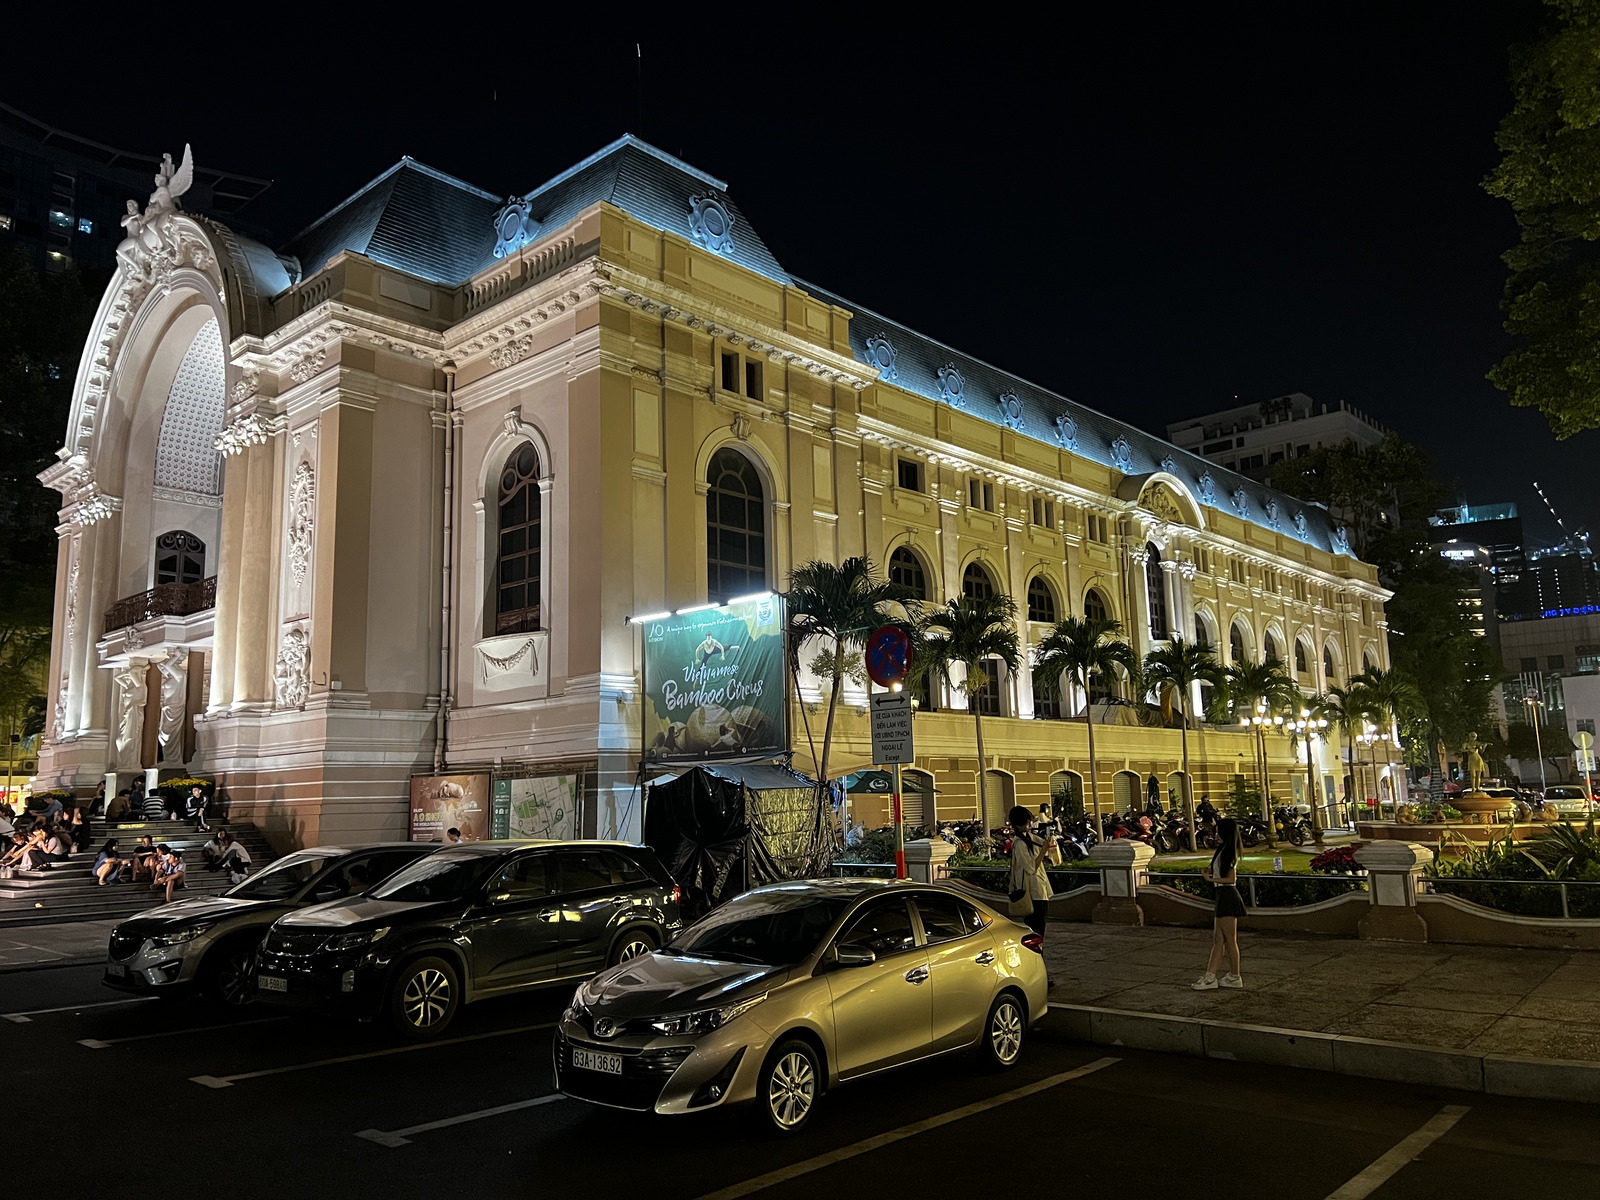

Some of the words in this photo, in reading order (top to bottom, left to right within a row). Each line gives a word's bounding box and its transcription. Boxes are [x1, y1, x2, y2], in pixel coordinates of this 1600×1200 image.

[682, 660, 740, 685] Vietnamese
[661, 679, 725, 711] Bamboo
[726, 678, 764, 701] Circus
[885, 754, 900, 762] Except
[574, 1051, 621, 1074] 63A-136.92
